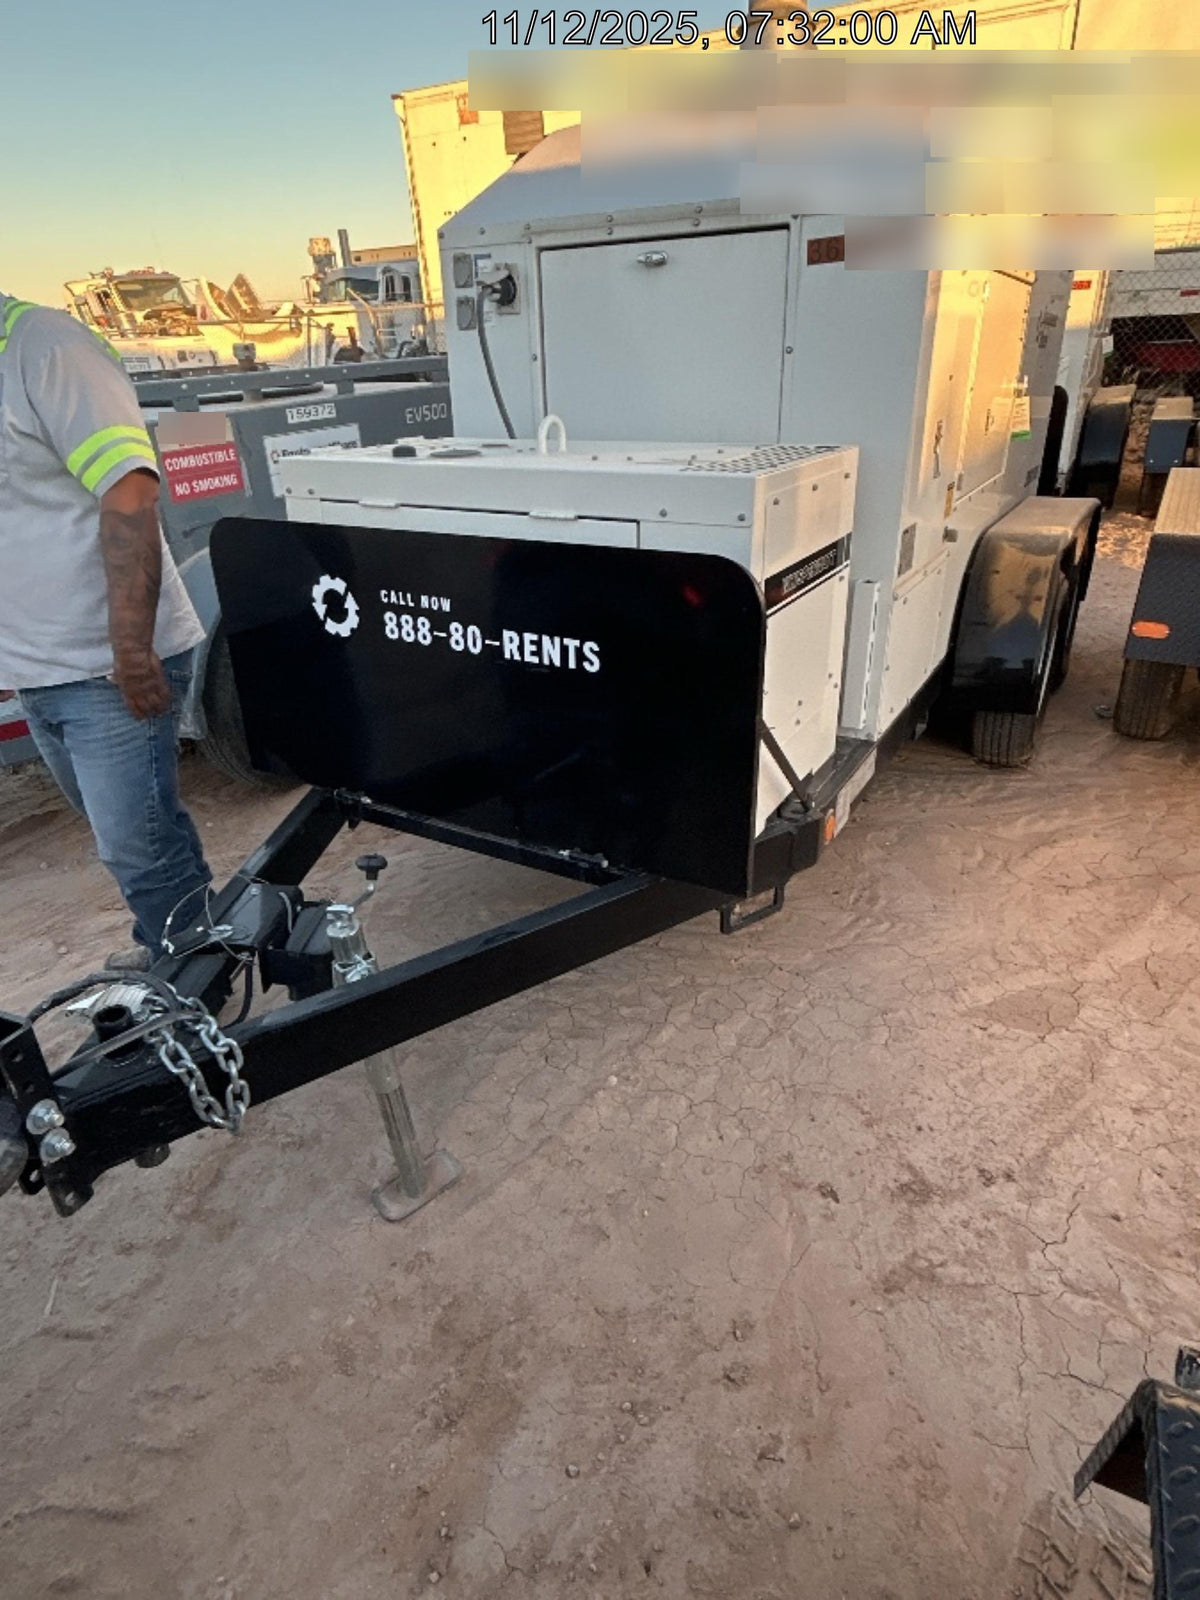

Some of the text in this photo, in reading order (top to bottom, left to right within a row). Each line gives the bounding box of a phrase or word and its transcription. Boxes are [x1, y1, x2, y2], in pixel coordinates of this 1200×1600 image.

[405, 403, 447, 424] EV500
[164, 448, 237, 471] COMBUSTIBLE
[174, 473, 239, 496] NO SMOKING
[380, 589, 451, 612] CALL NOW
[383, 610, 600, 673] 888-80-RENTS
